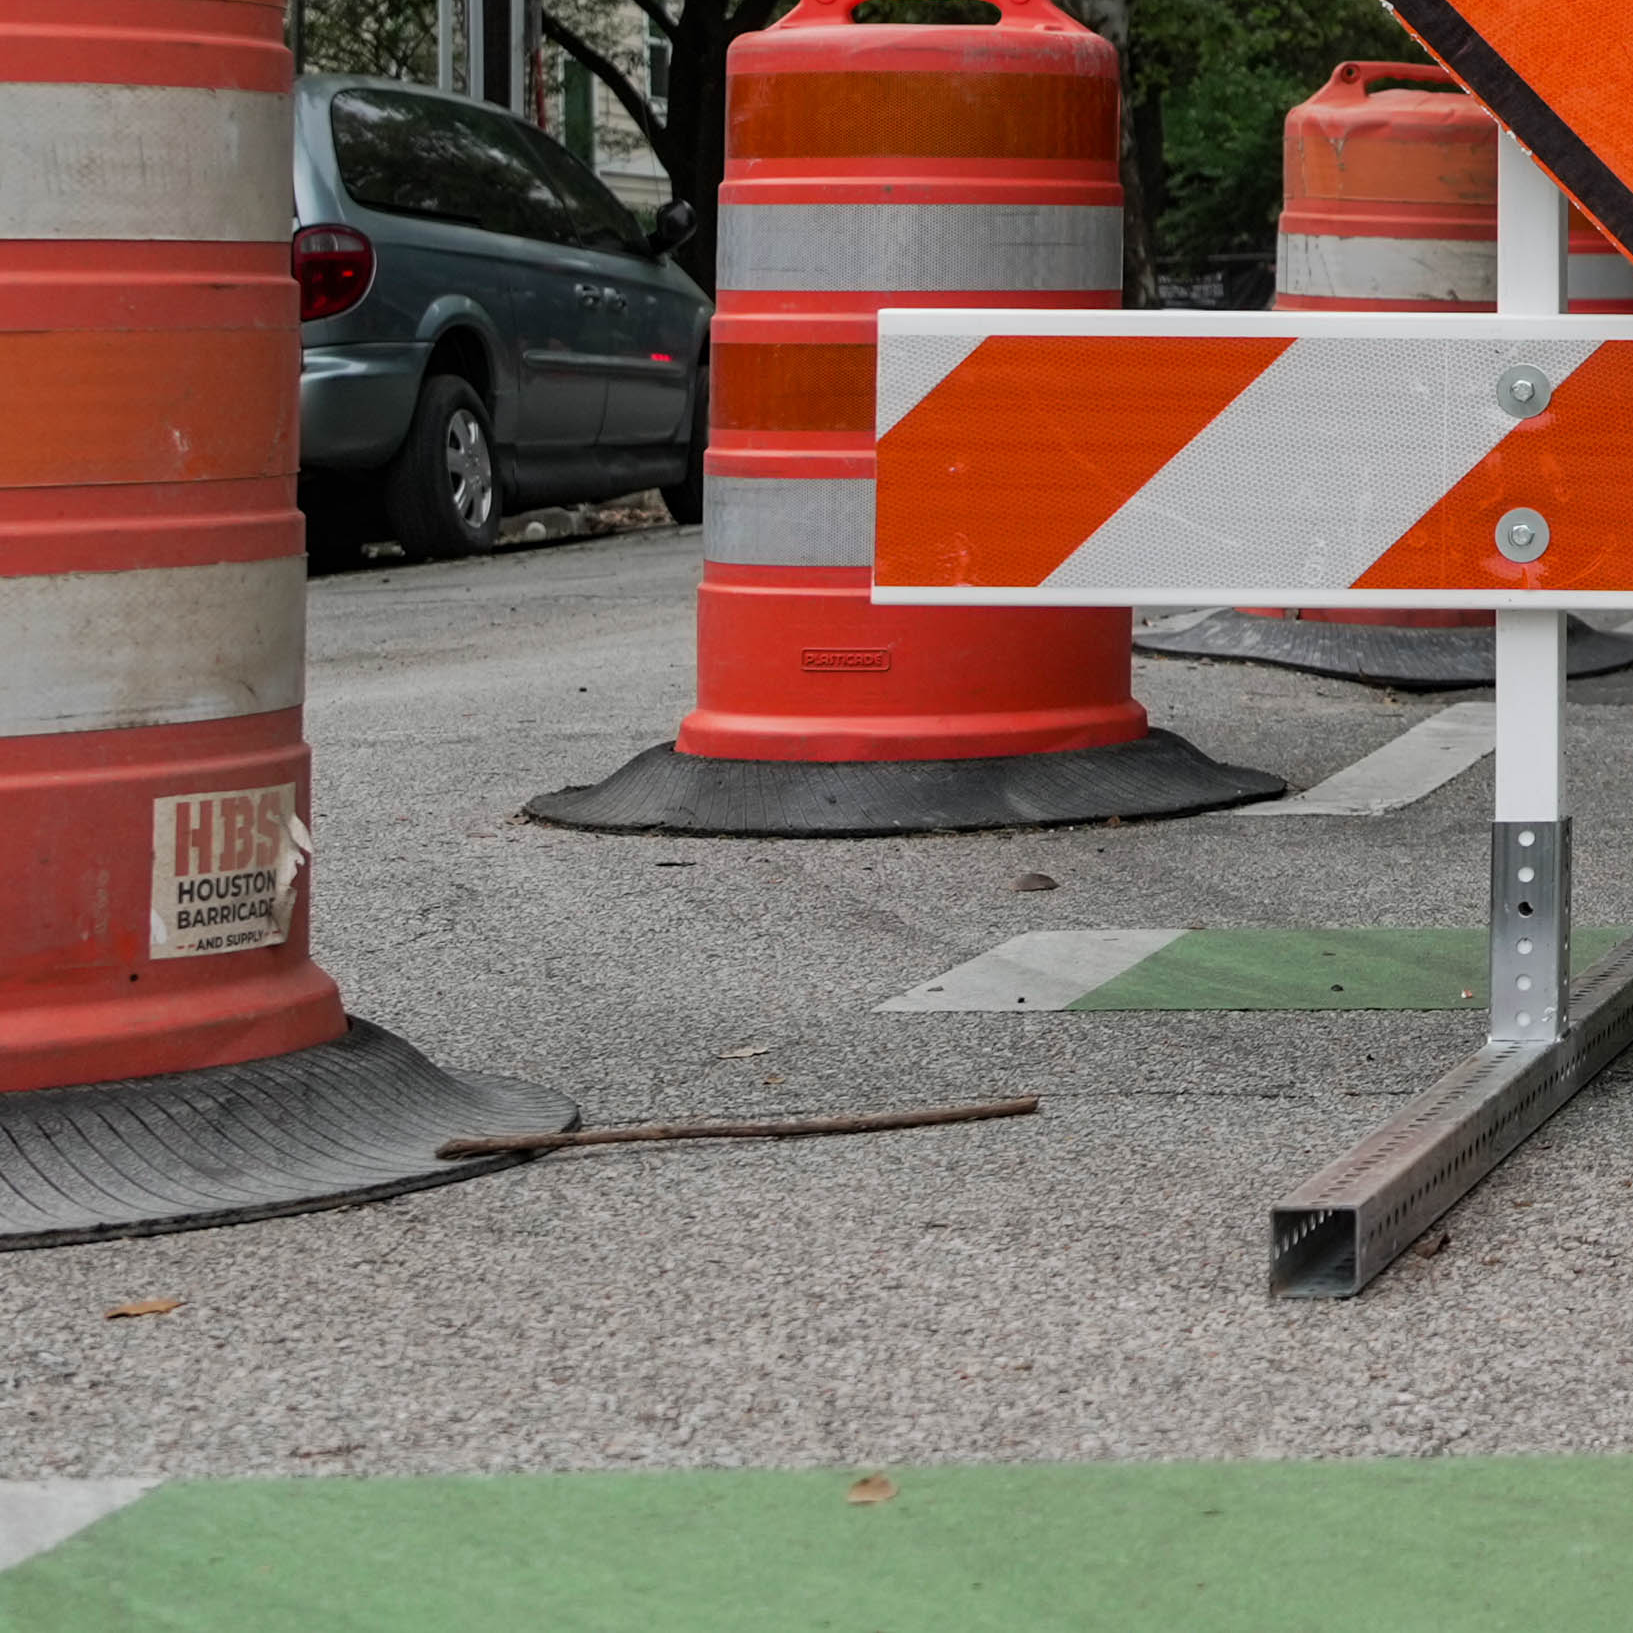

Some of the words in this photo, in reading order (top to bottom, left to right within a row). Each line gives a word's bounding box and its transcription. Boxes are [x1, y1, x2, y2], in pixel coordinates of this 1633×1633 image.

[175, 793, 282, 876] HBS
[177, 869, 277, 904] HOUSTON
[177, 898, 275, 930] BARRICADE
[196, 936, 223, 951] AND
[227, 930, 264, 947] SUPPLY
